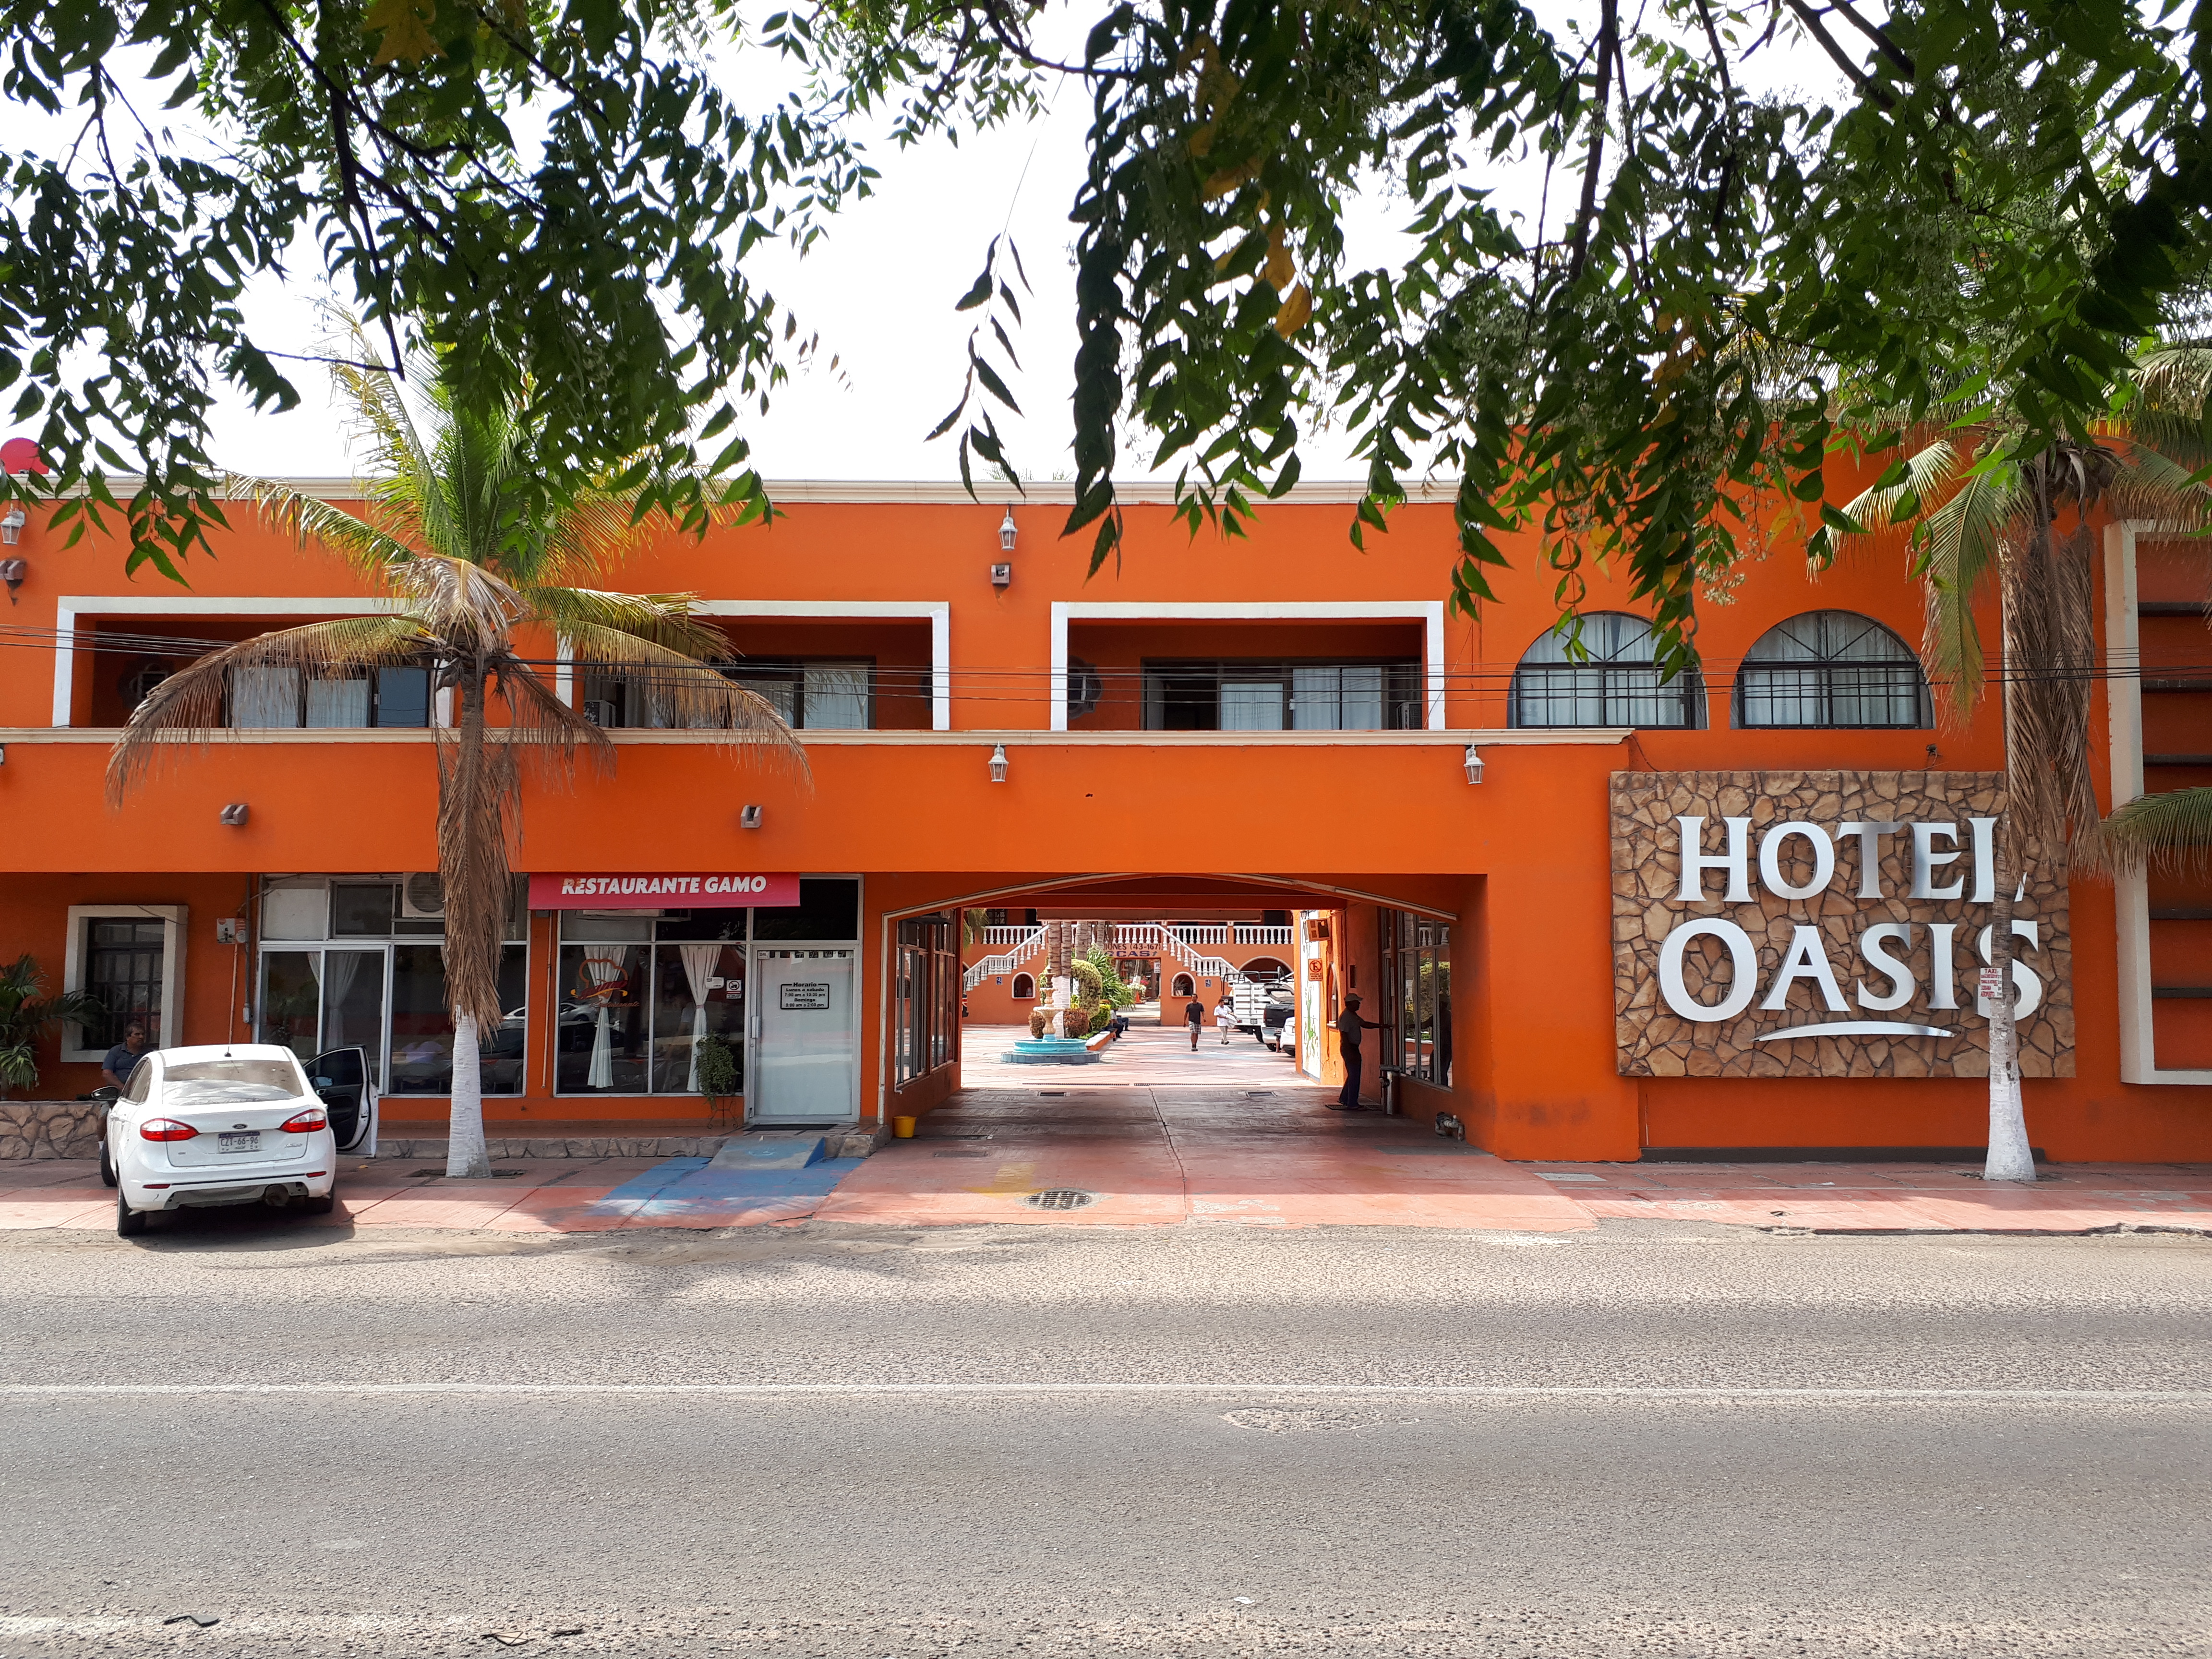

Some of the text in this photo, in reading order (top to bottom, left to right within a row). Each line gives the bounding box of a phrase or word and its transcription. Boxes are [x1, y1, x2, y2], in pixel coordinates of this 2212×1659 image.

[562, 876, 767, 894] RESTAURANTE GAMO
[1673, 817, 2027, 902] HOTEL
[1658, 918, 2042, 1022] OASIS
[221, 1136, 258, 1146] CZT-66-96
